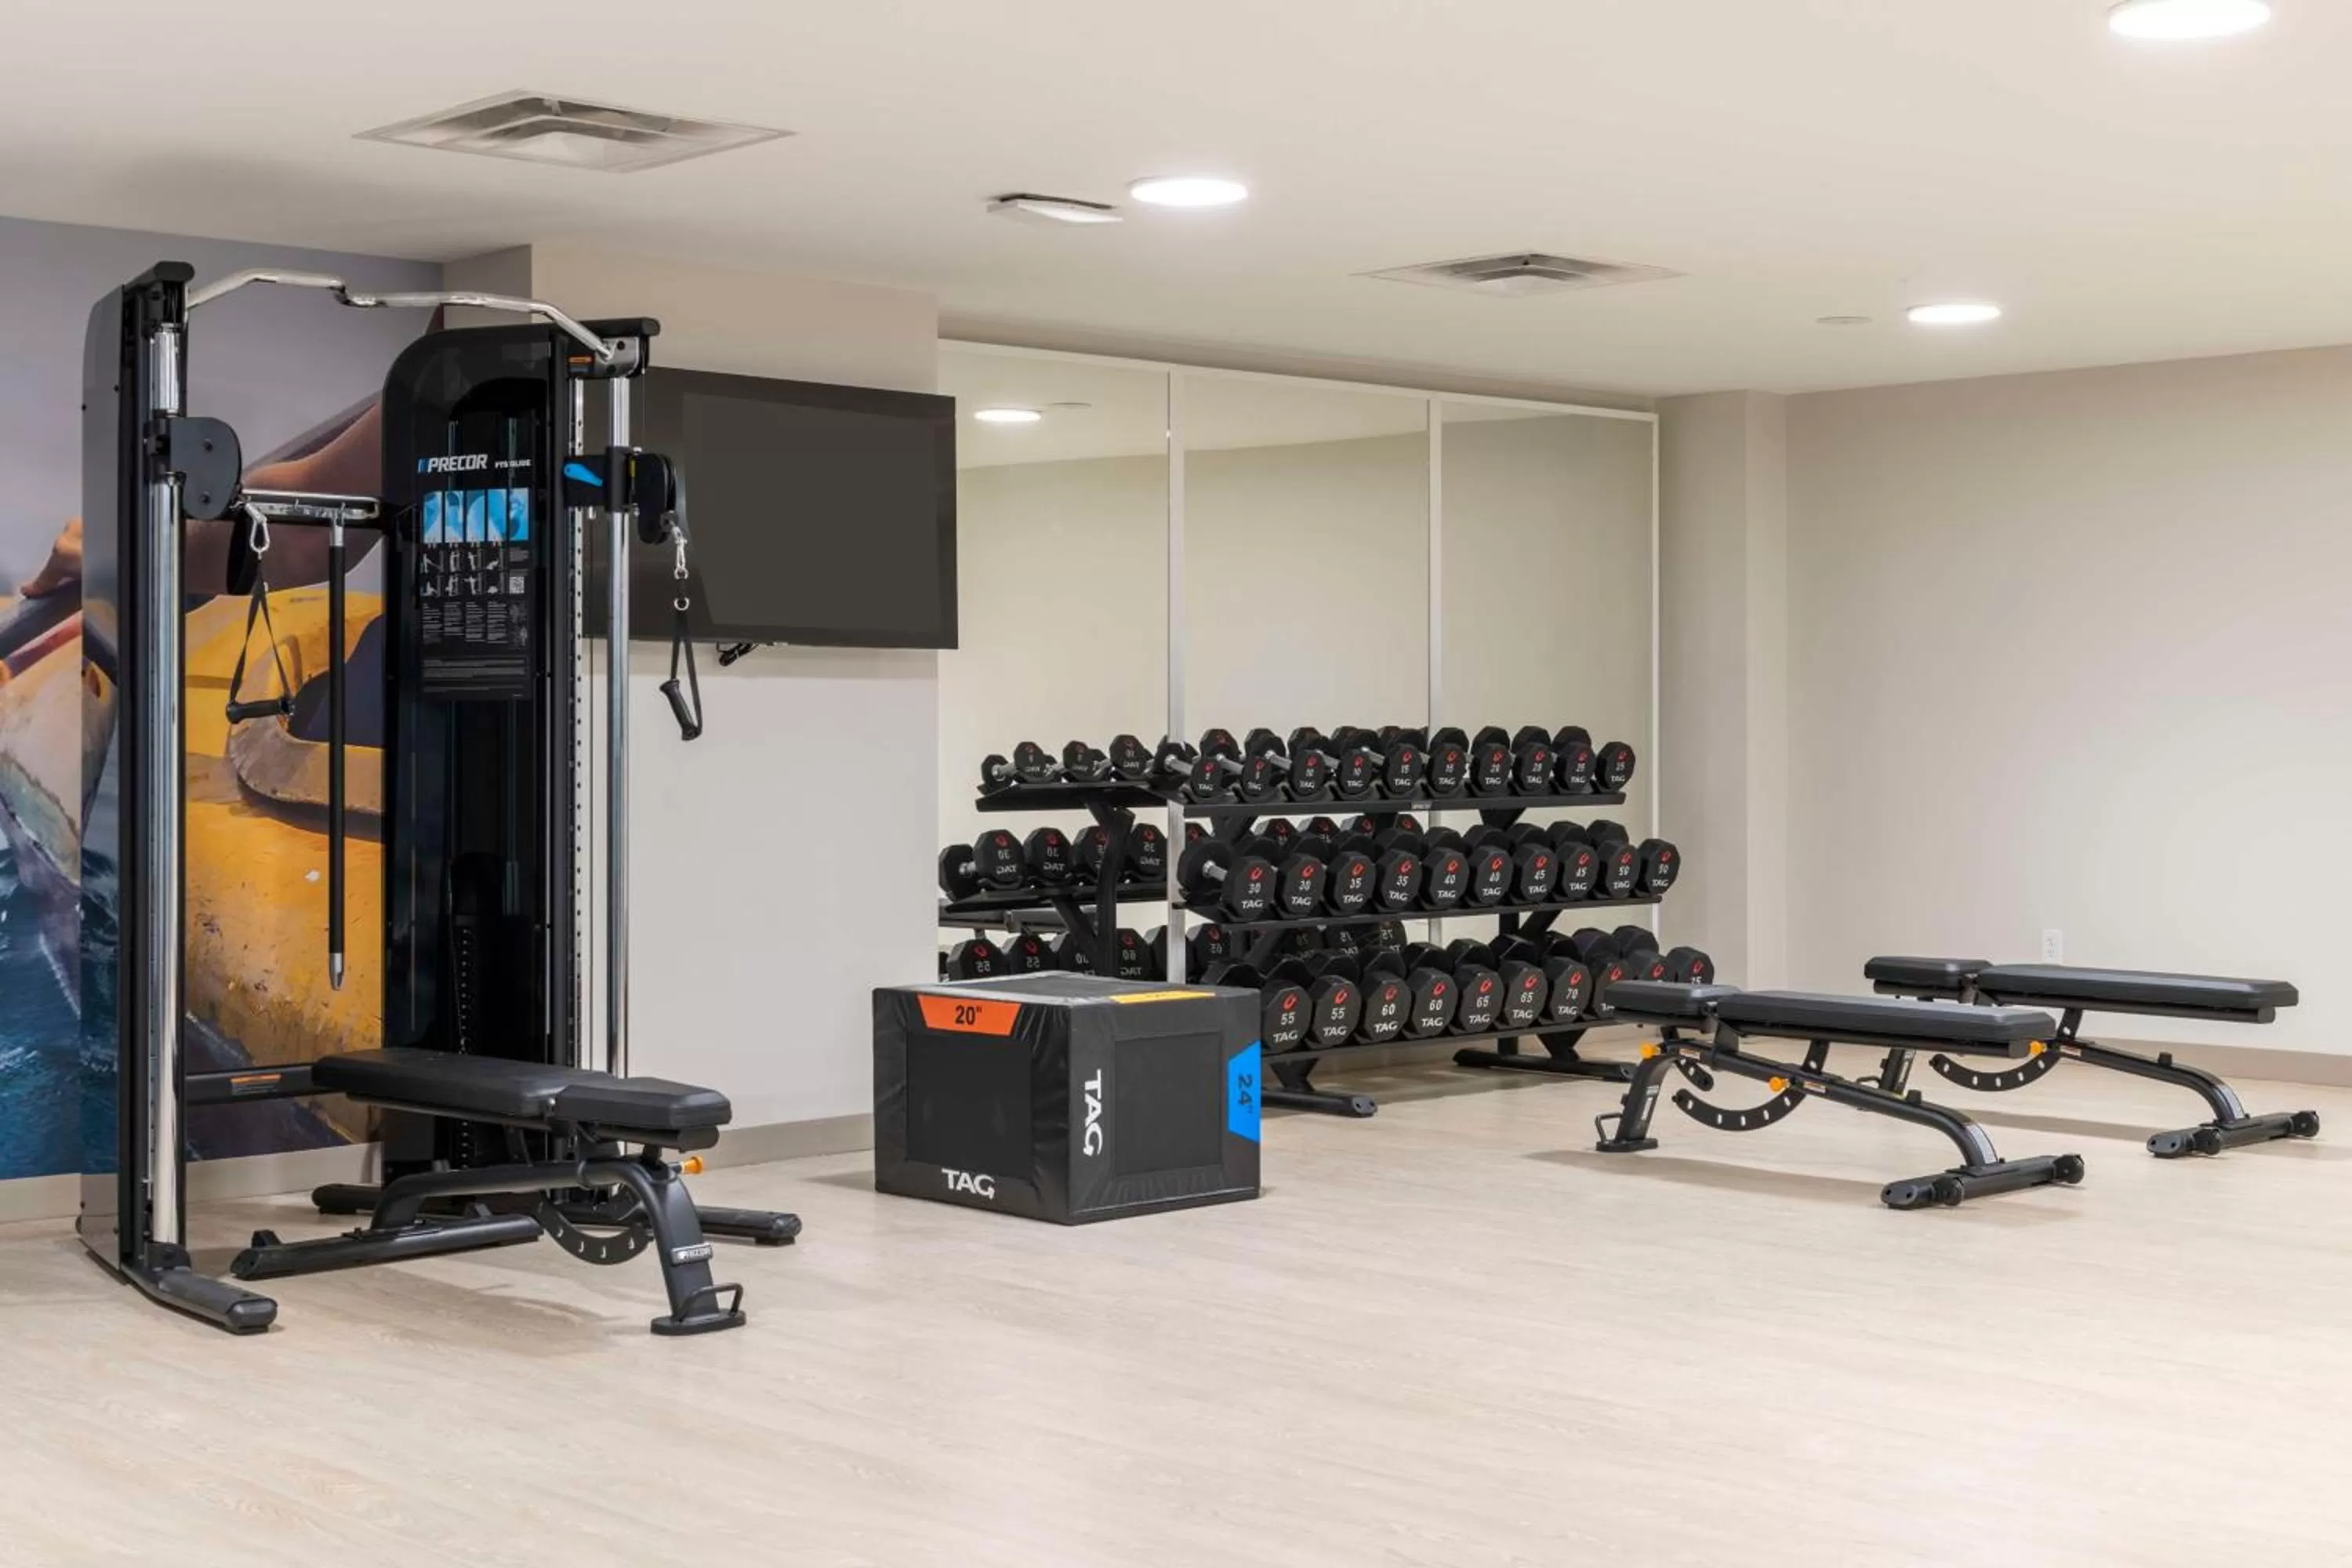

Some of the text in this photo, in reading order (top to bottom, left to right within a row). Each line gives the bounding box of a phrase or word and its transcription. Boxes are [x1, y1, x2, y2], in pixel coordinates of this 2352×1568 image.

[427, 454, 488, 473] PRECOR
[1438, 776, 1456, 785] TAG
[1526, 775, 1543, 784] TAG
[1534, 869, 1546, 880] 45
[1576, 867, 1588, 877] 45
[1618, 866, 1630, 876] 50
[1658, 865, 1669, 874] 50
[1396, 876, 1410, 886] 35
[1443, 875, 1457, 885] 40
[1489, 872, 1501, 882] 40
[1349, 878, 1363, 888] 35
[1570, 882, 1588, 891] TAG
[1613, 881, 1631, 890] TAG
[1652, 879, 1670, 887] TAG
[1437, 890, 1457, 898] TAG
[1483, 887, 1502, 896] TAG
[1528, 884, 1547, 894] TAG
[1291, 896, 1312, 906] TAG
[1342, 894, 1364, 903] TAG
[1388, 891, 1410, 901] TAG
[1241, 899, 1264, 909] TAG
[1519, 992, 1534, 1004] 65
[1565, 988, 1579, 1000] 70
[1428, 999, 1443, 1011] 60
[1475, 995, 1490, 1008] 65
[955, 1004, 982, 1025] 20"
[1330, 1007, 1345, 1020] 55
[1381, 1003, 1396, 1016] 60
[1512, 1008, 1534, 1019] TAG
[1557, 1004, 1578, 1016] TAG
[1279, 1012, 1296, 1025] 55
[1421, 1017, 1444, 1028] TAG
[1468, 1013, 1490, 1024] TAG
[1323, 1025, 1347, 1036] TAG
[1374, 1021, 1398, 1033] TAG
[1272, 1030, 1298, 1043] TAG
[1083, 1068, 1102, 1157] TAG
[941, 1167, 995, 1200] TAG
